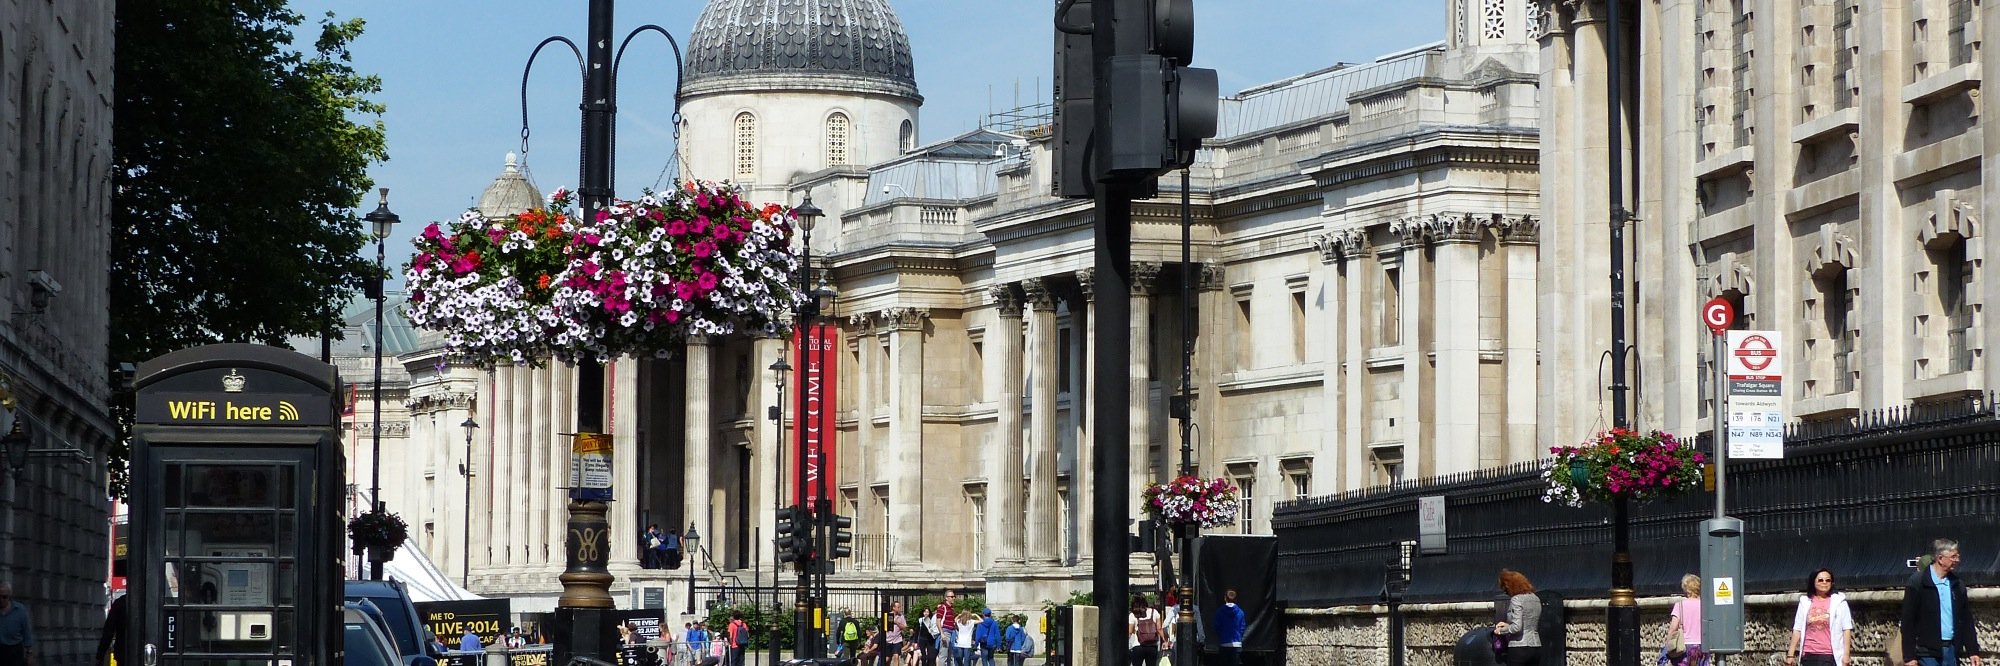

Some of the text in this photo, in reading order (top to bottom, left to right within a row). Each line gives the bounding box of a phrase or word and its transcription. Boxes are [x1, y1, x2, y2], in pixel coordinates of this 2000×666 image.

[1708, 304, 1726, 326] G
[168, 401, 272, 421] WiFi here
[443, 612, 455, 620] TO
[435, 621, 463, 635] LIVE
[467, 620, 499, 633] 2014
